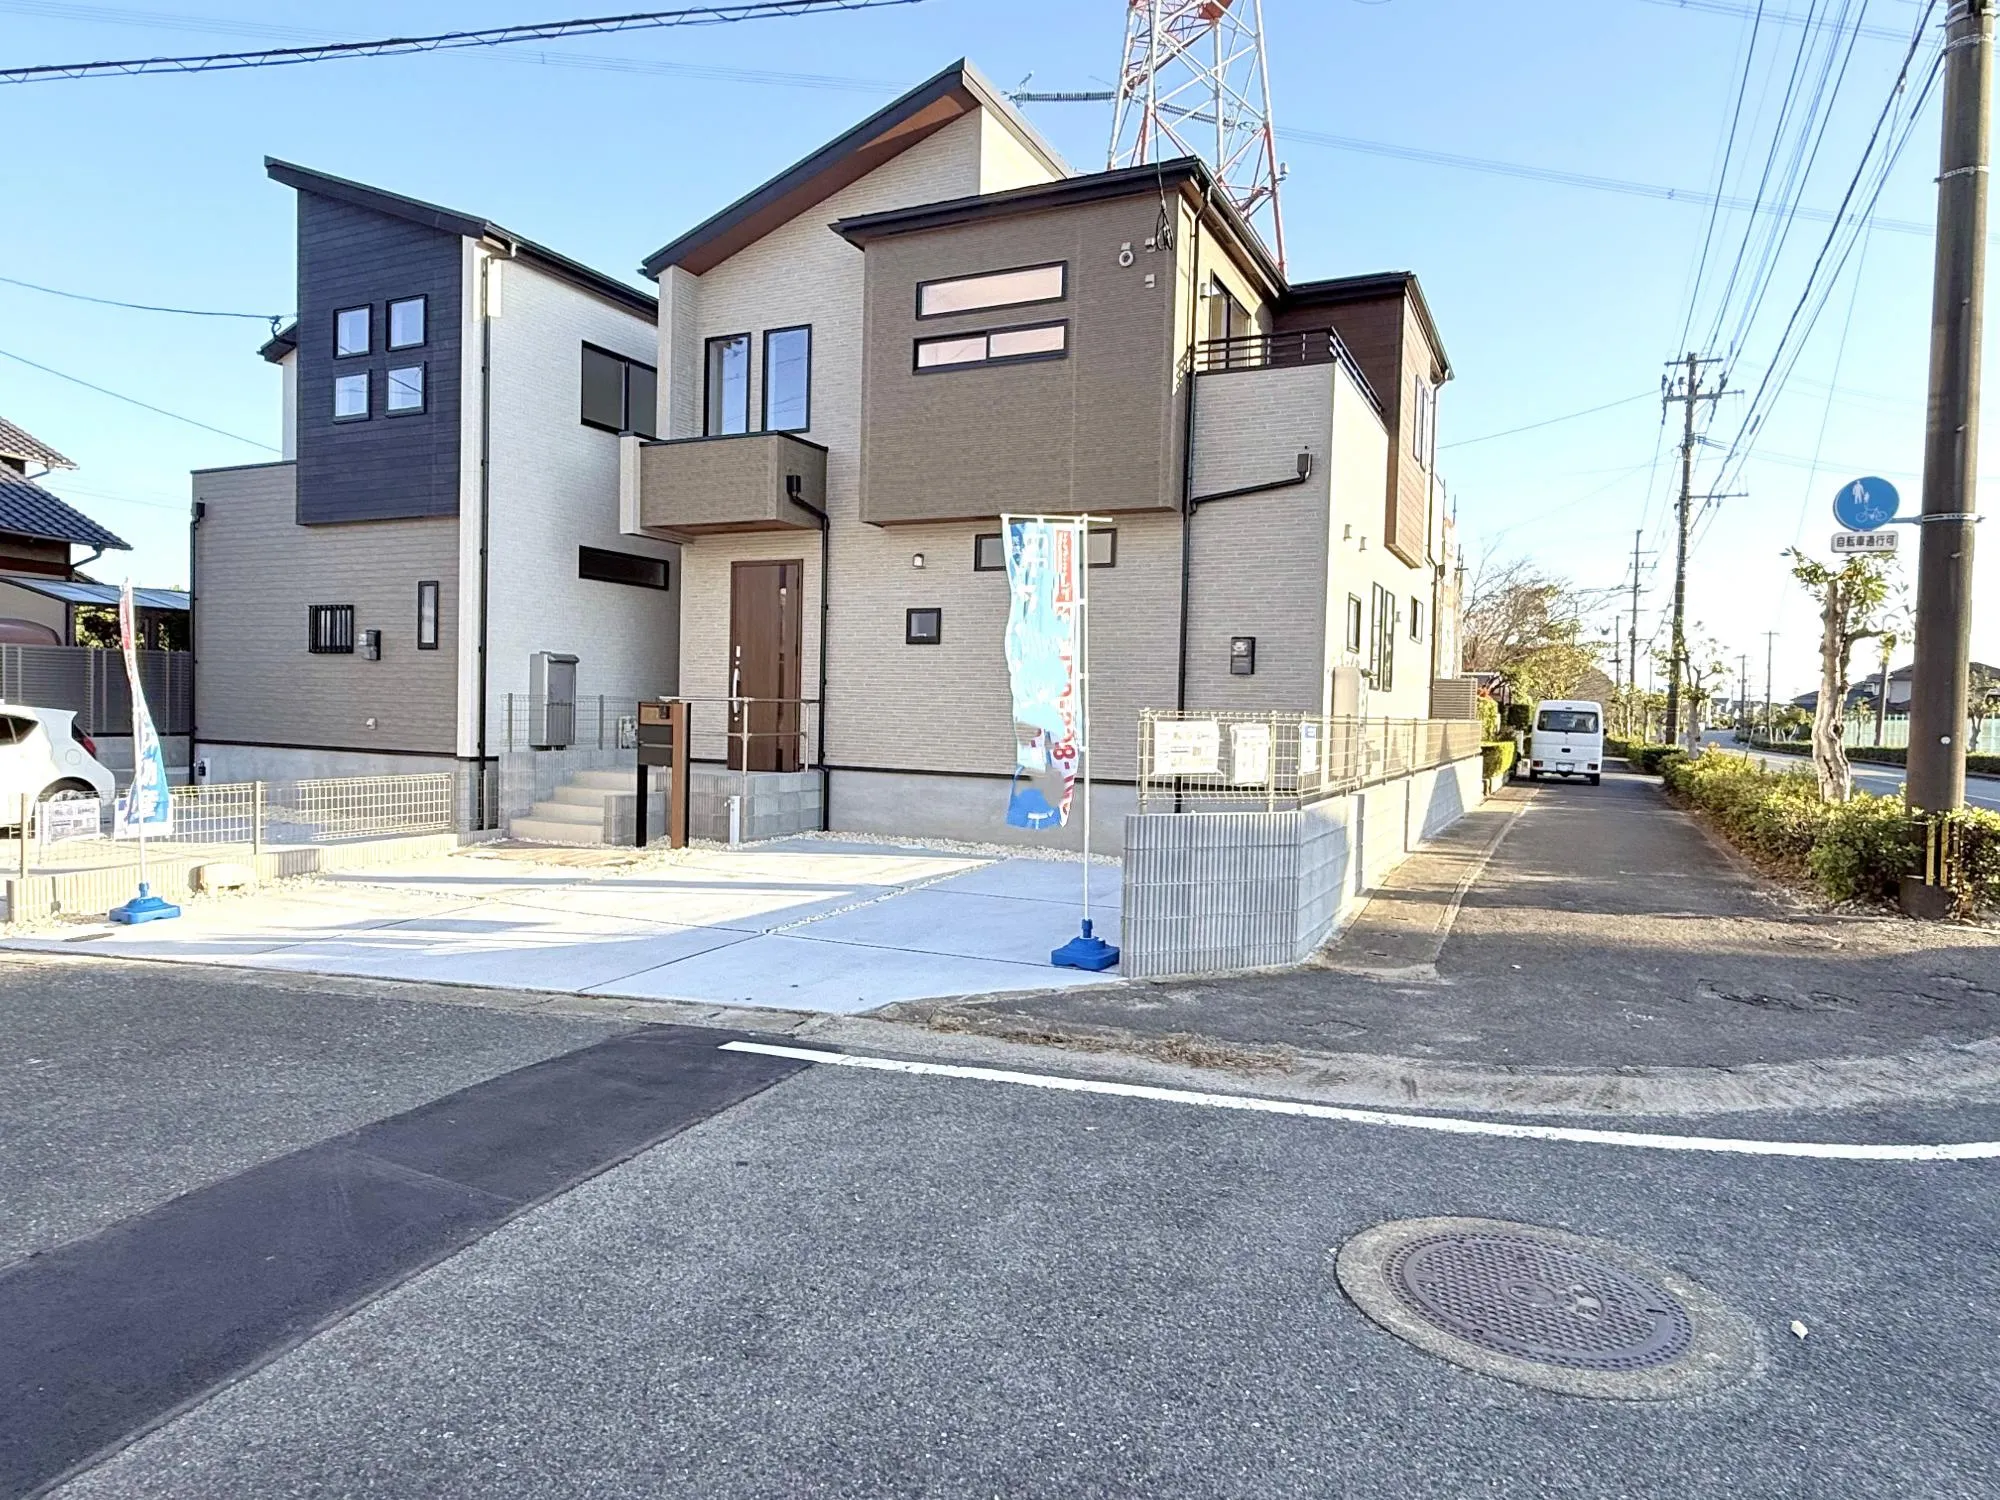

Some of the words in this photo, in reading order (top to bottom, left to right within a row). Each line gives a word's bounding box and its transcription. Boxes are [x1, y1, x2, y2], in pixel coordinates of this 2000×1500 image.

[1836, 535, 1895, 547] 自転車通行可
